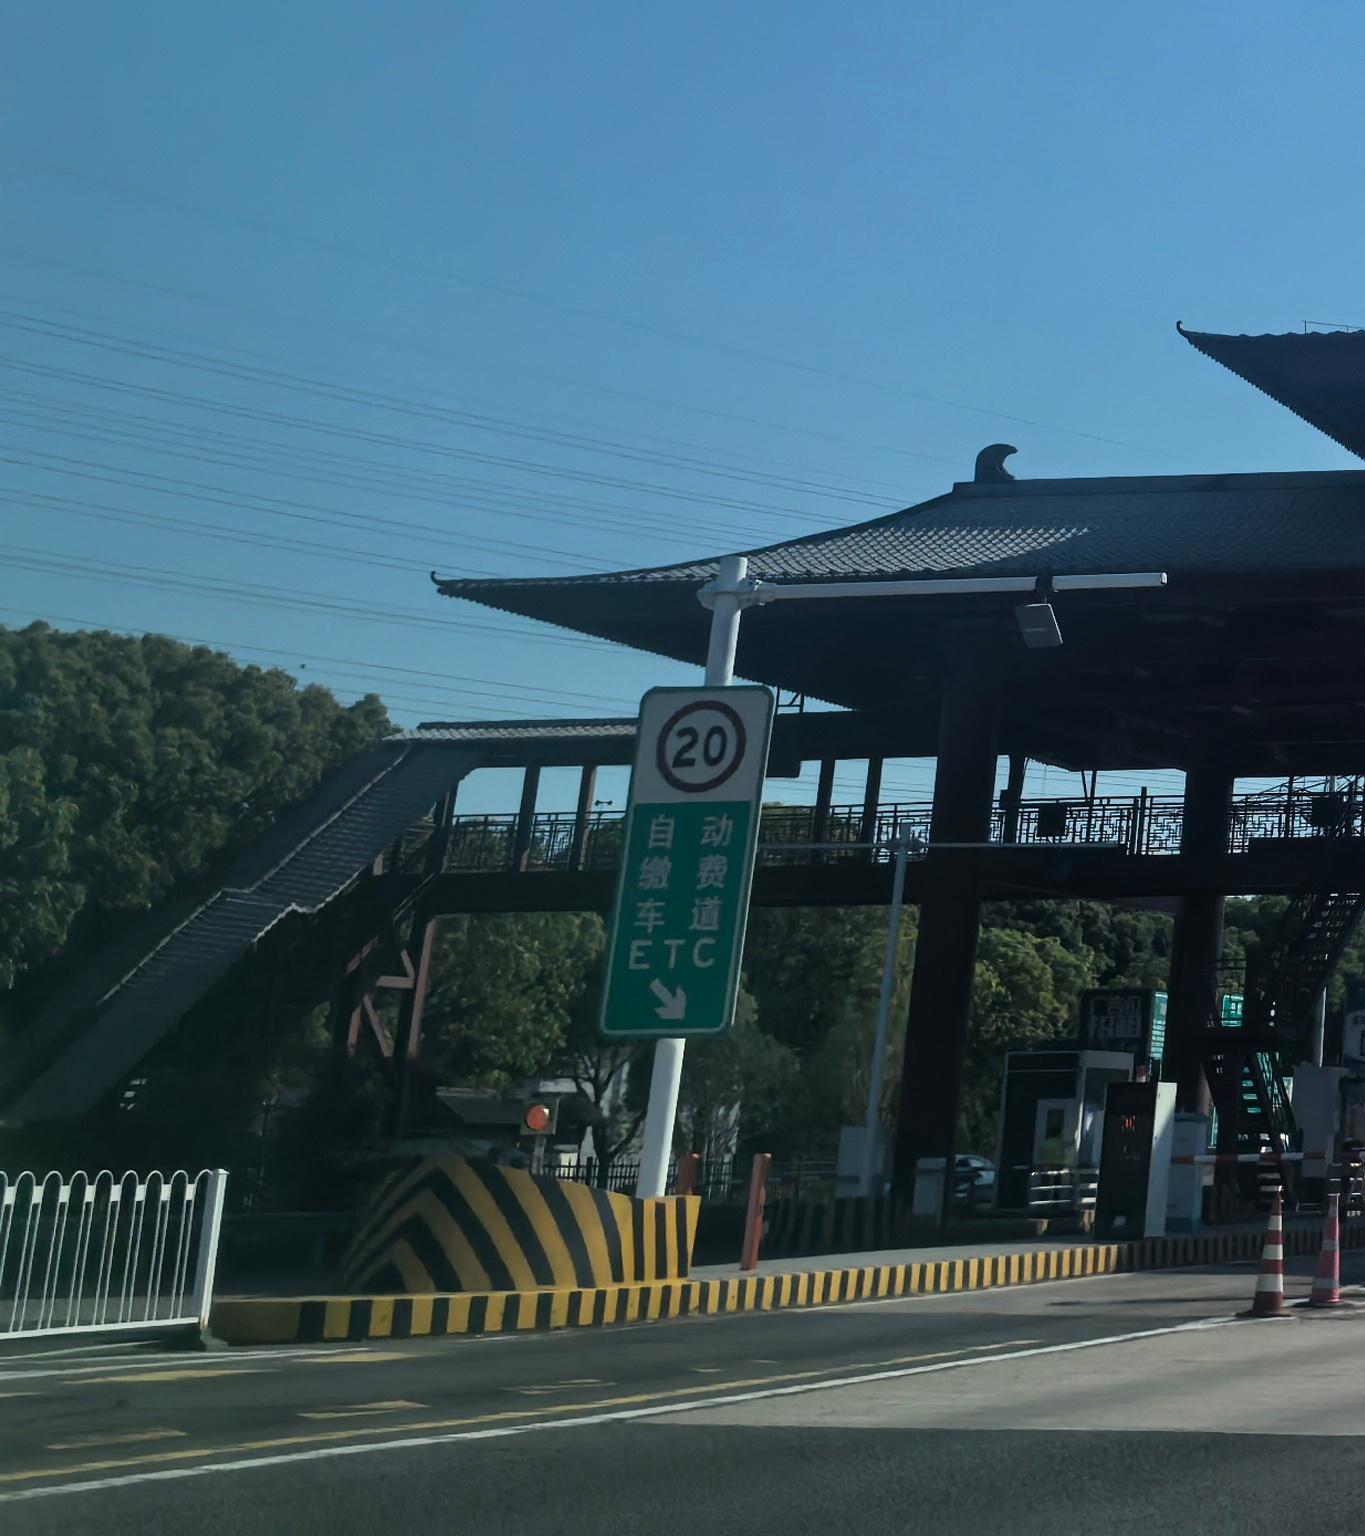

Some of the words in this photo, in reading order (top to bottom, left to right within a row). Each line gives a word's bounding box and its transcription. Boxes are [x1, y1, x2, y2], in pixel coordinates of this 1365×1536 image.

[672, 724, 727, 769] 20
[646, 814, 734, 850] 自动
[637, 855, 726, 892] 缴费
[633, 897, 721, 934] 车道
[627, 938, 717, 971] ETC
